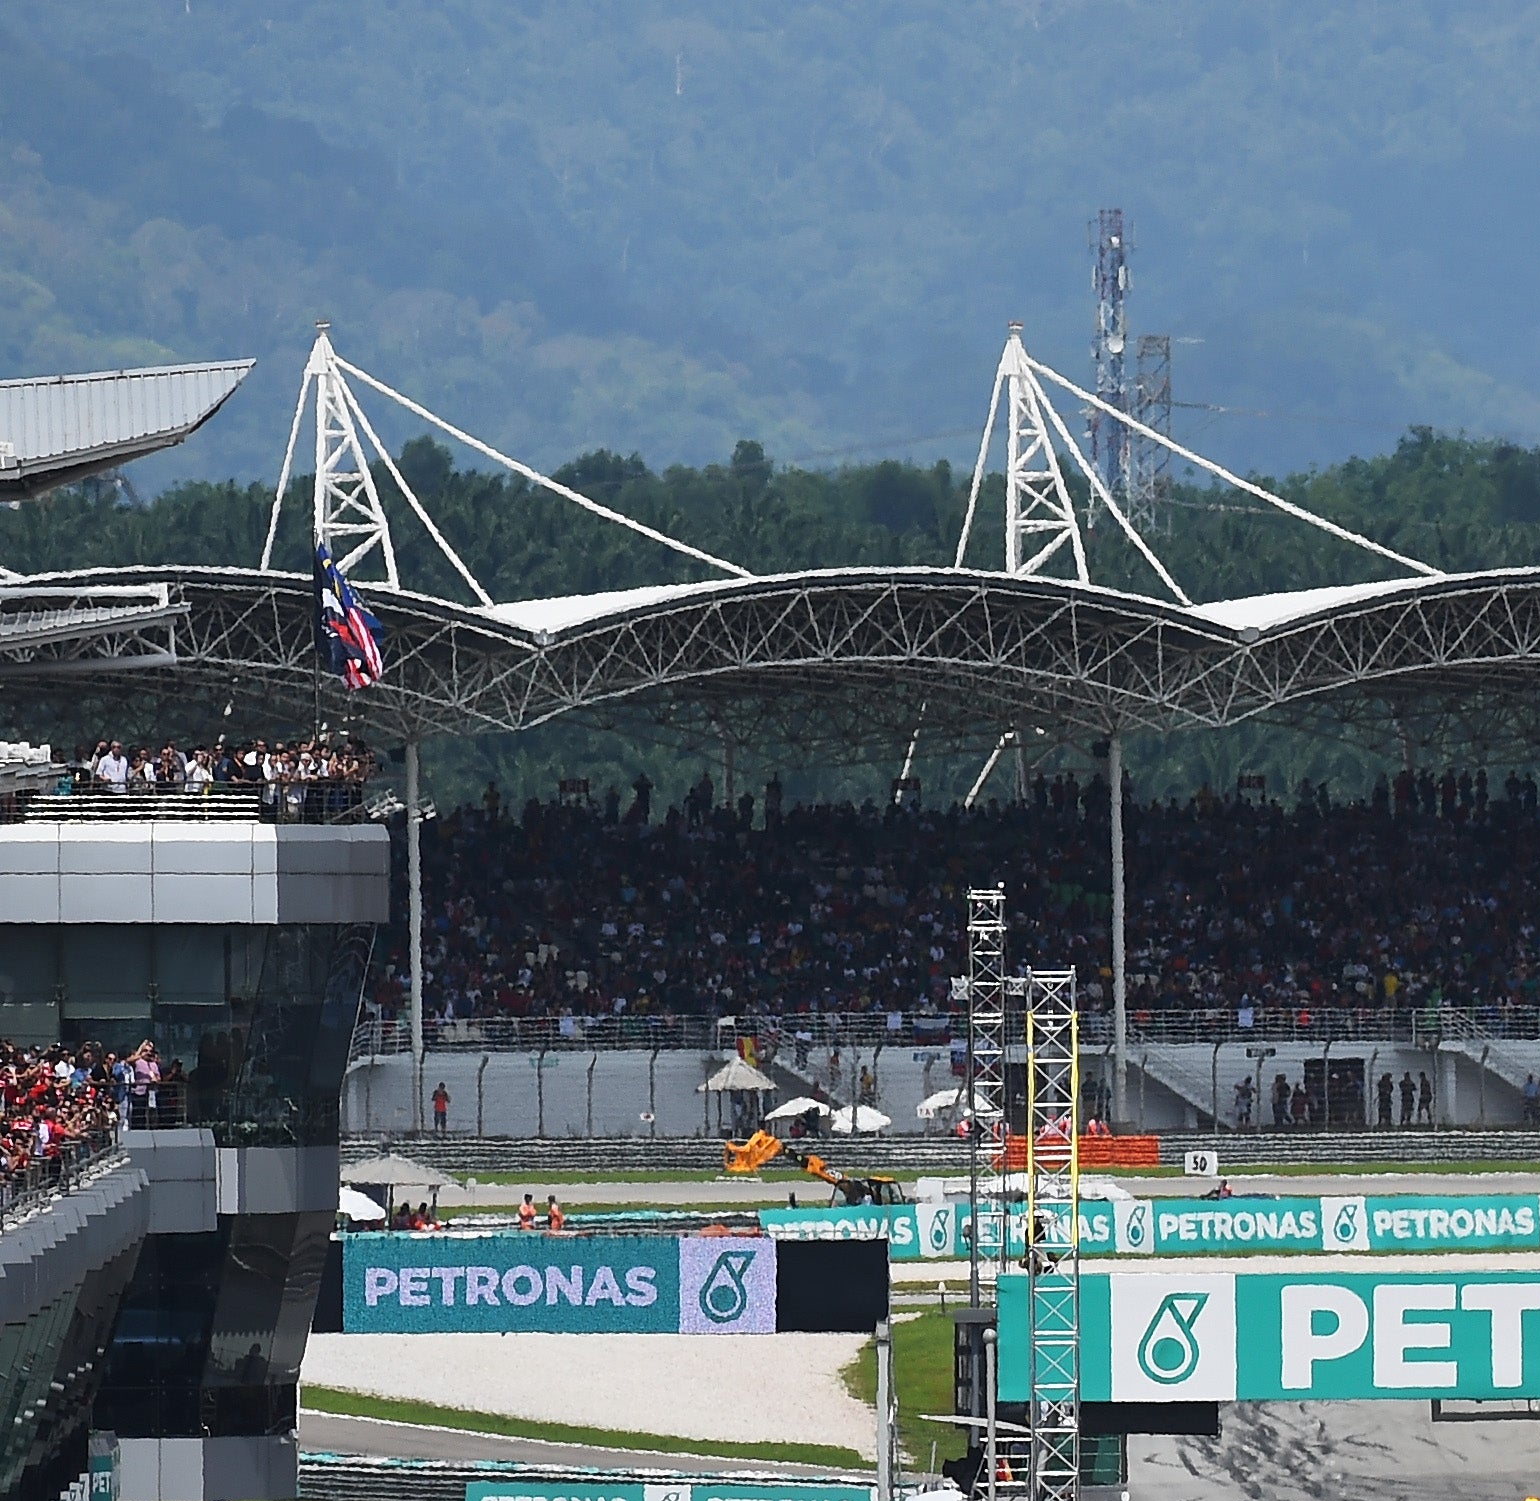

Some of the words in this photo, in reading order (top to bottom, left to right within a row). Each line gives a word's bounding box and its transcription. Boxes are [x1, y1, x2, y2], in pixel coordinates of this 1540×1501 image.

[1158, 1210, 1318, 1241] PETRONAS
[1373, 1207, 1535, 1238] PETRONAS
[364, 1264, 658, 1307] PETRONAS
